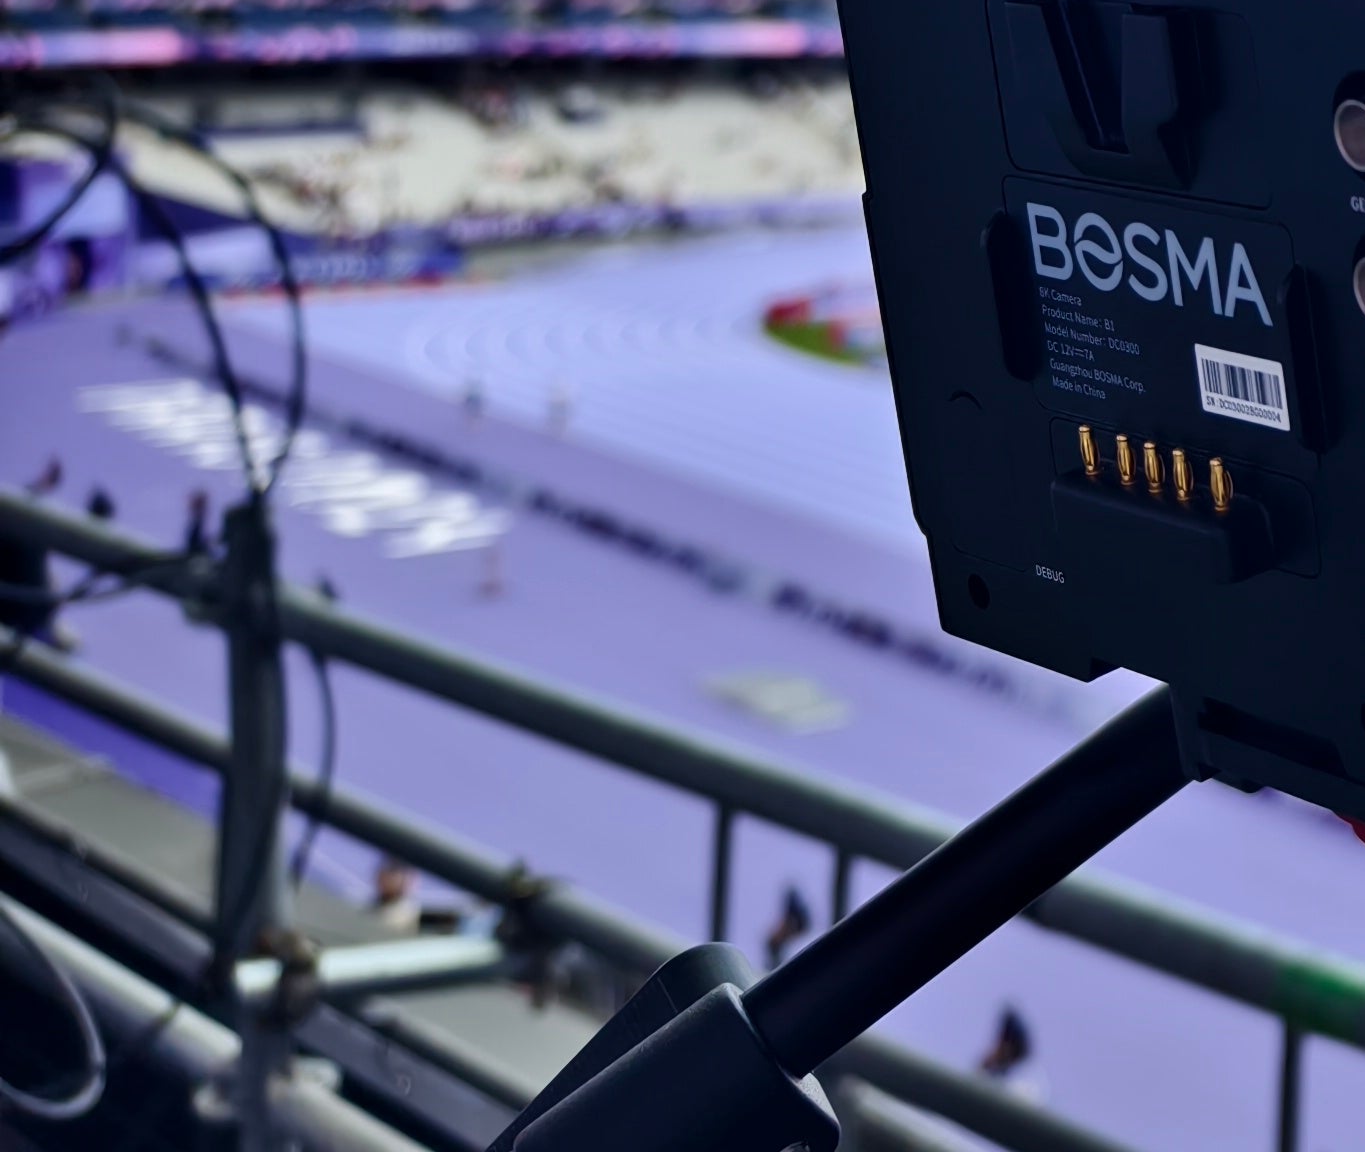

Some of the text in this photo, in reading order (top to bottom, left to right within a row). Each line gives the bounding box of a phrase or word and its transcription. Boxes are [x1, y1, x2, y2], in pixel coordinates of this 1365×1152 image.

[1026, 202, 1273, 327] BOSMA
[1050, 290, 1082, 307] Camera
[1042, 304, 1074, 322] Product
[1075, 311, 1102, 327] Name:
[1044, 322, 1068, 338] Model
[1070, 328, 1105, 346] Number:
[1048, 340, 1059, 353] DC
[1050, 357, 1146, 394] Guangzhou BOSMA Corp.
[1052, 375, 1073, 392] Made
[1083, 383, 1106, 400] China
[1035, 564, 1065, 584] DEBUG
